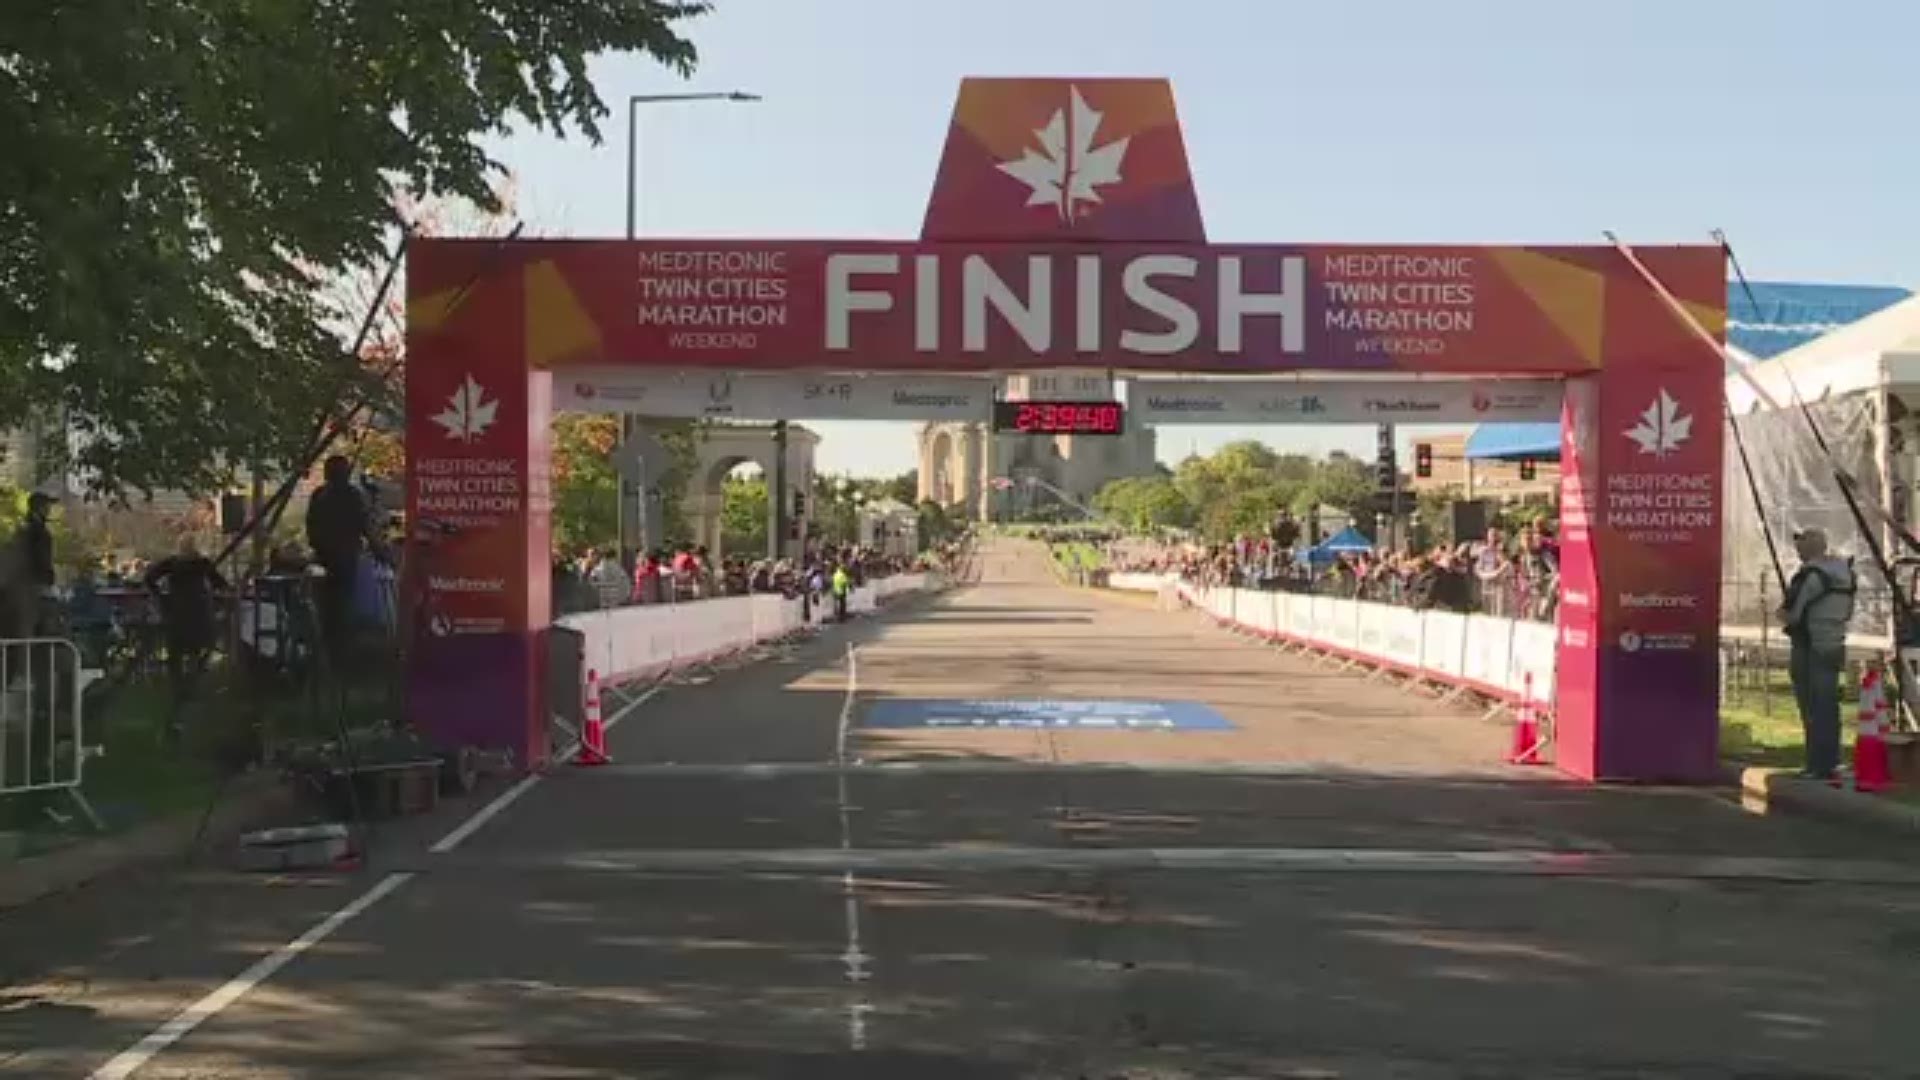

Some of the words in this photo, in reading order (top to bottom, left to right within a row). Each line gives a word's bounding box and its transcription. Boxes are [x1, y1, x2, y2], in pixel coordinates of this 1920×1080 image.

[638, 252, 787, 273] MEDTRONIC
[1325, 256, 1474, 278] MEDTRONIC
[639, 278, 701, 299] TWIN
[706, 278, 787, 299] CITIES
[1325, 283, 1387, 304] TWIN
[1392, 283, 1474, 304] CITIES
[825, 254, 1304, 354] FINISH
[638, 305, 787, 326] MARATHON
[1325, 310, 1474, 331] MARATHON
[669, 333, 757, 350] WEEKEND
[1355, 338, 1445, 354] WEEKEND
[416, 458, 518, 475] MEDTRONIC
[417, 477, 460, 493] TWIN
[464, 477, 519, 493] CITIES
[1607, 474, 1712, 490] MEDTRONIC
[416, 496, 519, 511] MARATHON
[1608, 494, 1653, 508] TWIN
[1656, 494, 1712, 508] CITIES
[1607, 512, 1712, 526] MARATHON
